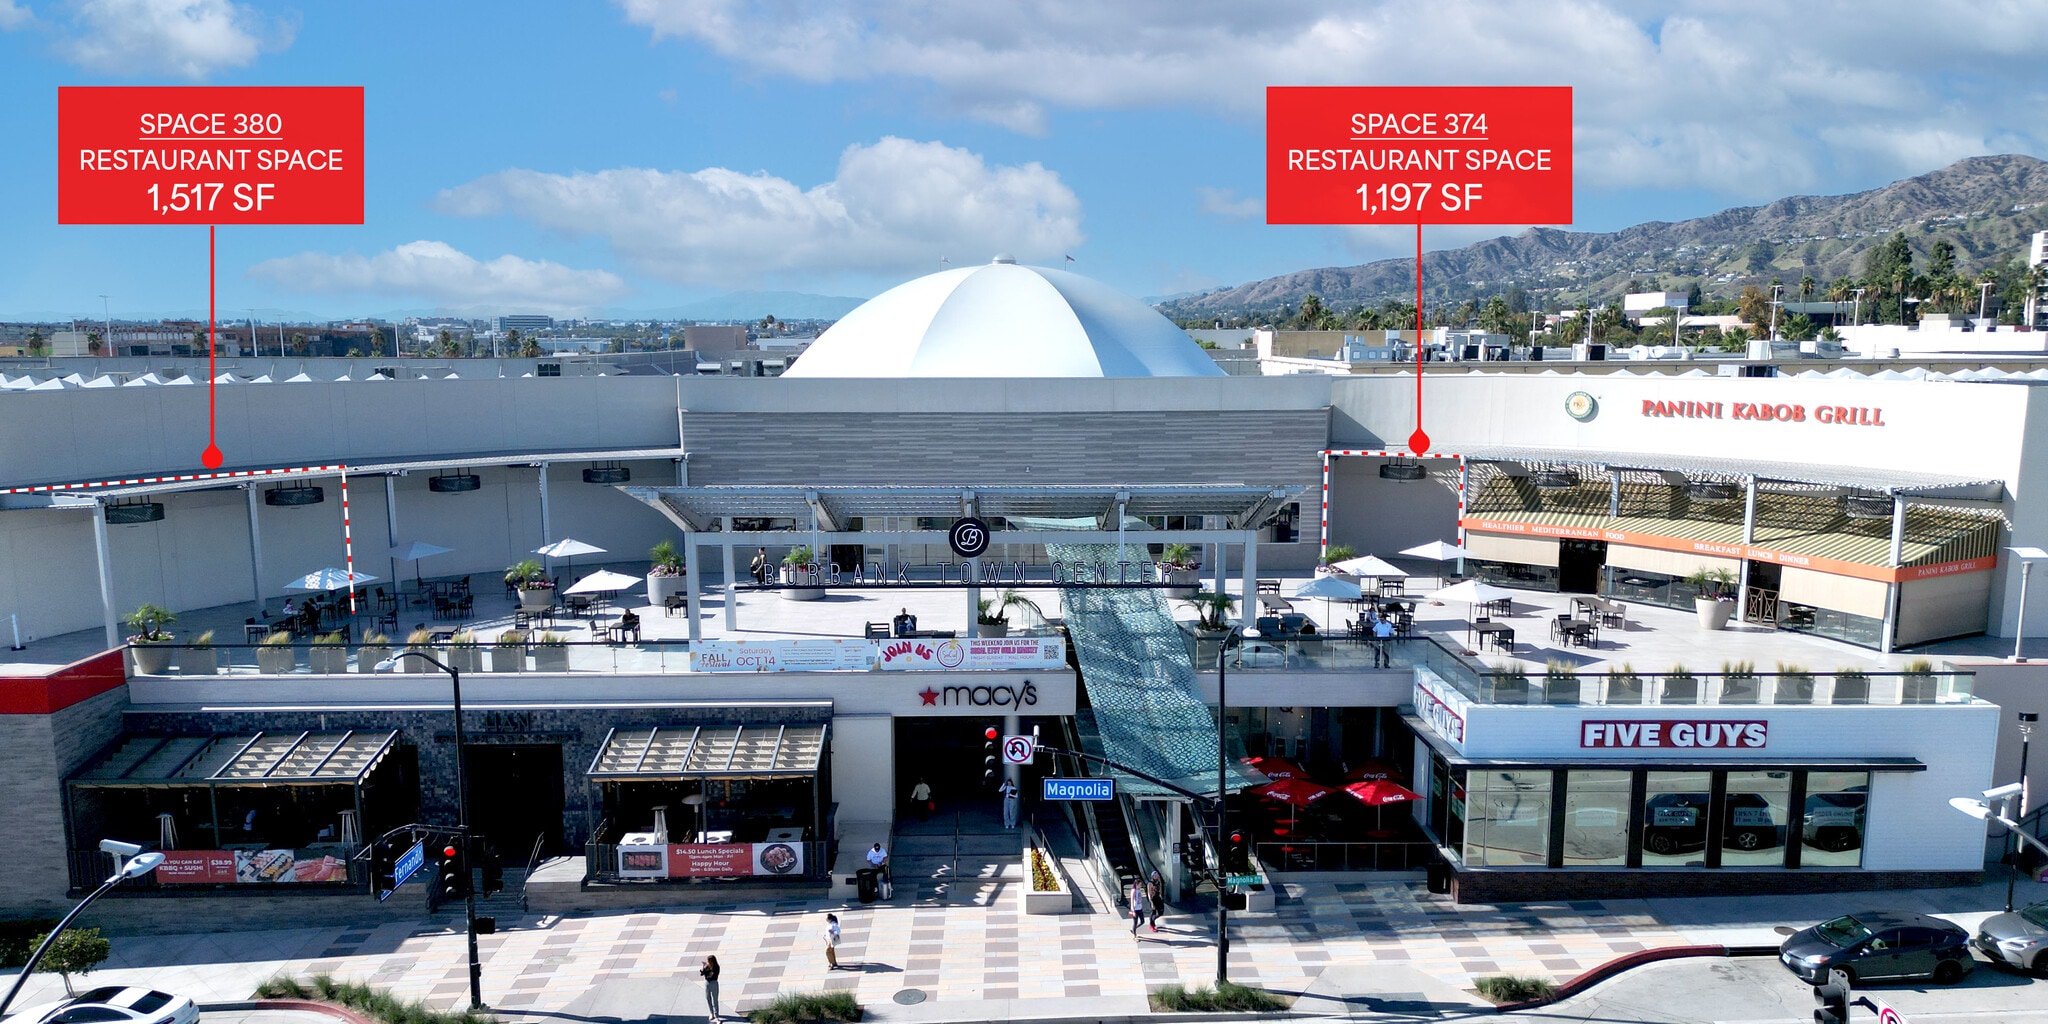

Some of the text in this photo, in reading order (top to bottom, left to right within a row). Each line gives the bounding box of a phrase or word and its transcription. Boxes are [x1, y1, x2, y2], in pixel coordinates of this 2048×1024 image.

[1641, 399, 1885, 426] PANINI KABOB GRILL
[1482, 521, 1625, 540] HEALTHIER MEDITERRANEAN FOOD
[1694, 543, 1809, 565] BREAKFAST LUNCH DINNER
[763, 561, 1175, 586] BURBANK TOWN CENTER
[1918, 562, 1976, 577] PANINI KABOB GRILL
[702, 653, 727, 662] FALL
[740, 647, 772, 655] Saturday
[882, 641, 912, 662] JOIN
[915, 643, 934, 660] US
[736, 656, 760, 666] OCT
[764, 656, 776, 665] 14
[486, 712, 531, 731] HAN
[1414, 686, 1462, 740] FIVE GUYS
[1584, 722, 1766, 747] FIVE GUYS
[1047, 782, 1110, 799] Magnolia
[1227, 876, 1254, 886] Magnolia
